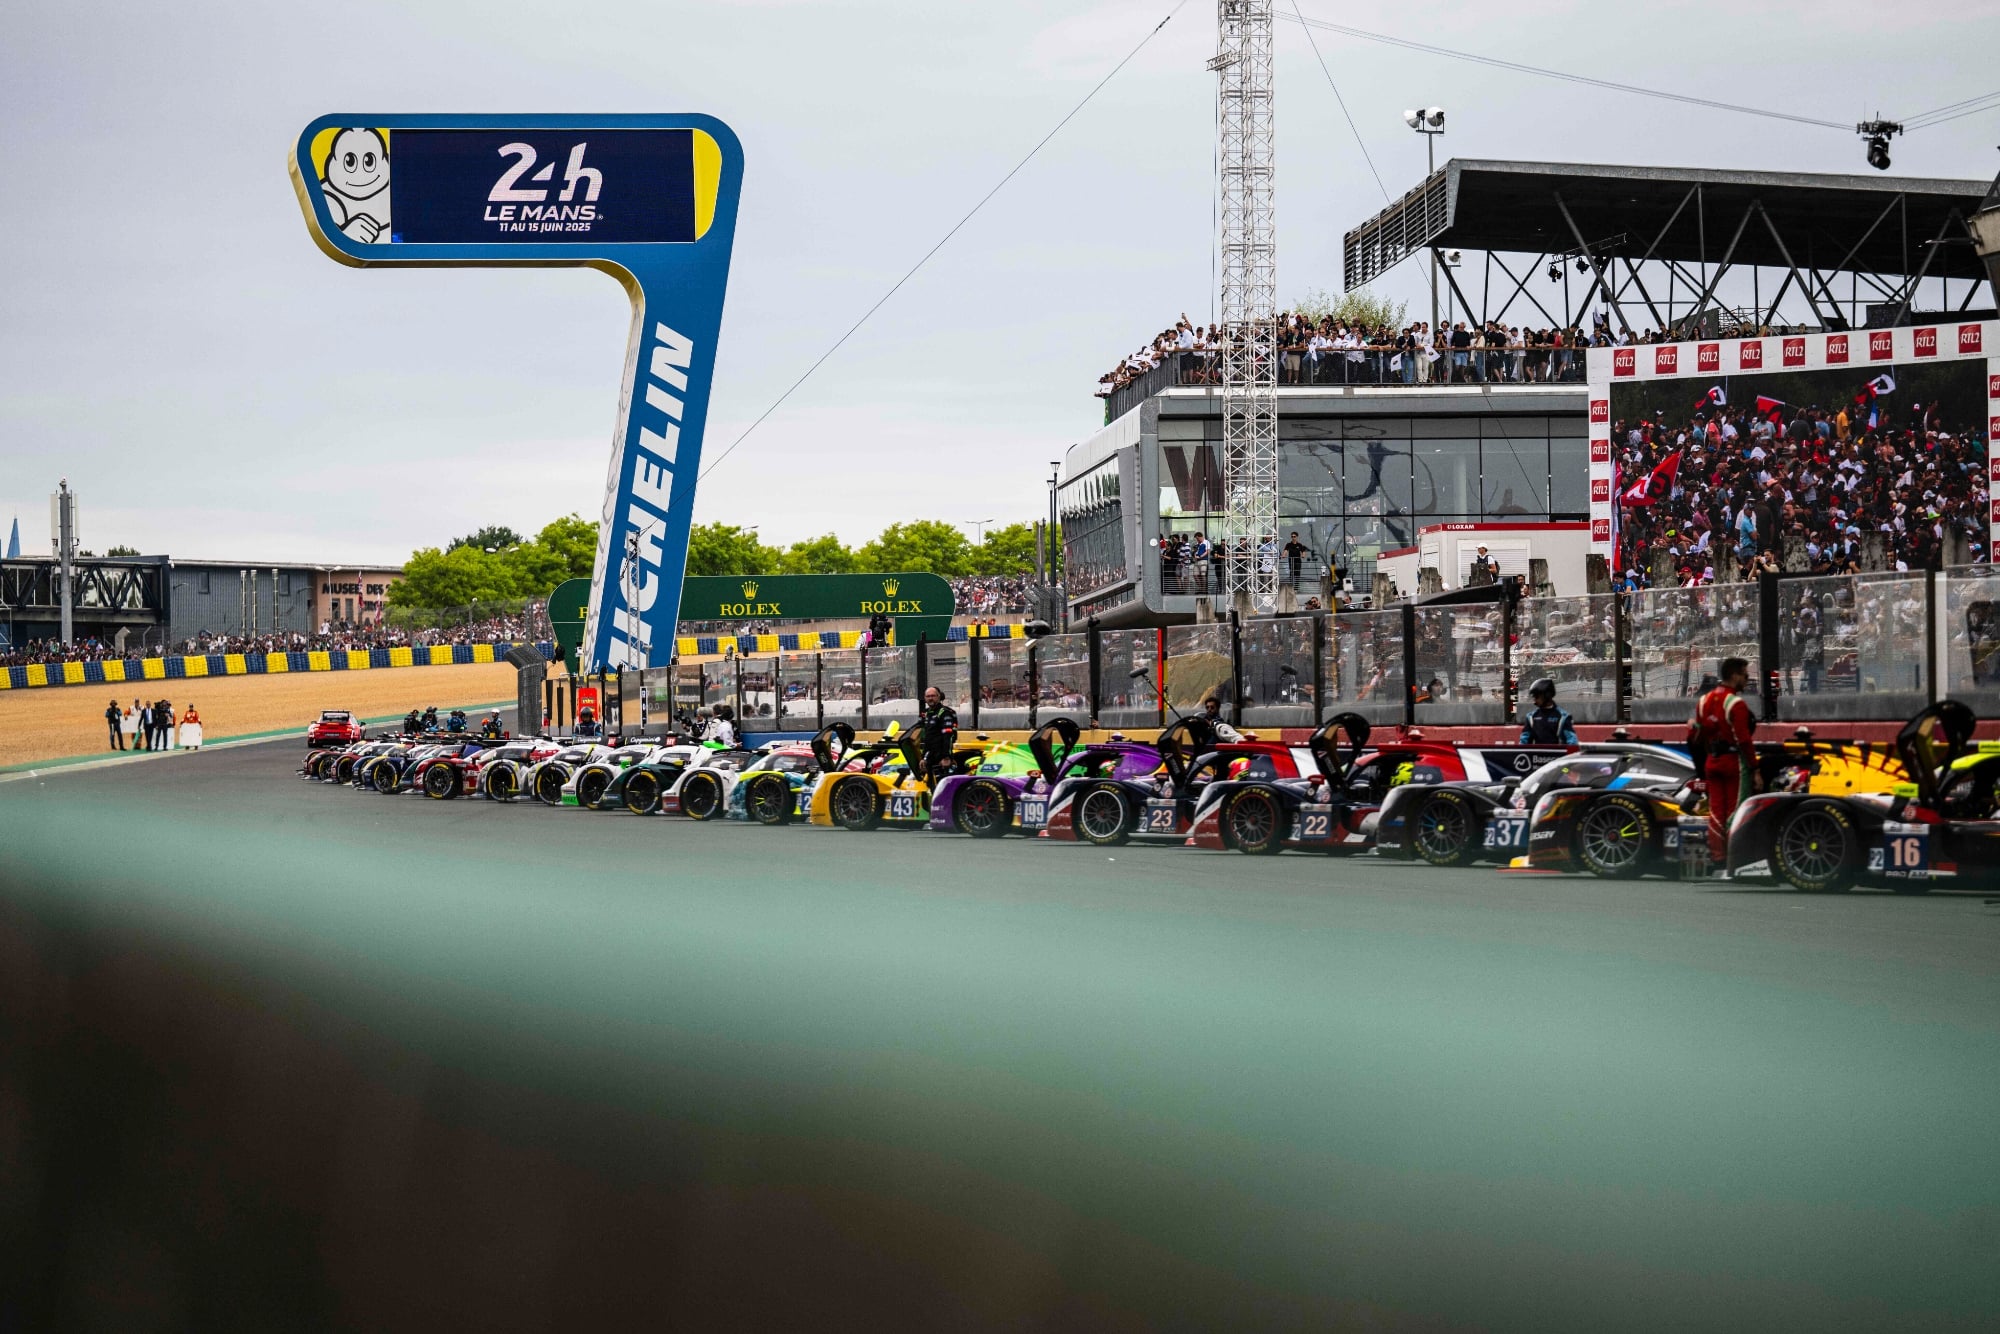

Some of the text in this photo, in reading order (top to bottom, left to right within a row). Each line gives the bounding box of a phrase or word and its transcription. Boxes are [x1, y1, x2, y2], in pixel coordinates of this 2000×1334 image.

[487, 142, 603, 201] 24h
[484, 205, 517, 221] LE
[500, 223, 591, 233] 11 AU 15 JUIN 2025
[1871, 339, 1891, 351] RTL2
[1915, 335, 1936, 348] RTL2
[1960, 332, 1981, 345] RTL2
[1742, 348, 1761, 360] RTL2
[1784, 345, 1804, 358] RTL2
[1828, 342, 1848, 354] RTL2
[1614, 356, 1634, 368] RTL2
[1657, 353, 1676, 365] RTL2
[1699, 350, 1719, 363] RTL2
[1592, 406, 1608, 415] RTL2
[1592, 446, 1608, 455] RTL2
[1593, 485, 1608, 495] RTL2
[1594, 525, 1609, 534] RTL2
[720, 603, 782, 616] ROLEX
[861, 600, 922, 614] ROLEX
[893, 798, 913, 816] 43
[1024, 803, 1044, 819] 199
[1150, 809, 1173, 827] 23
[1824, 805, 1849, 828] EAGLE
[1304, 816, 1328, 835] 22
[1497, 820, 1526, 847] 37
[1891, 837, 1921, 867] 16
